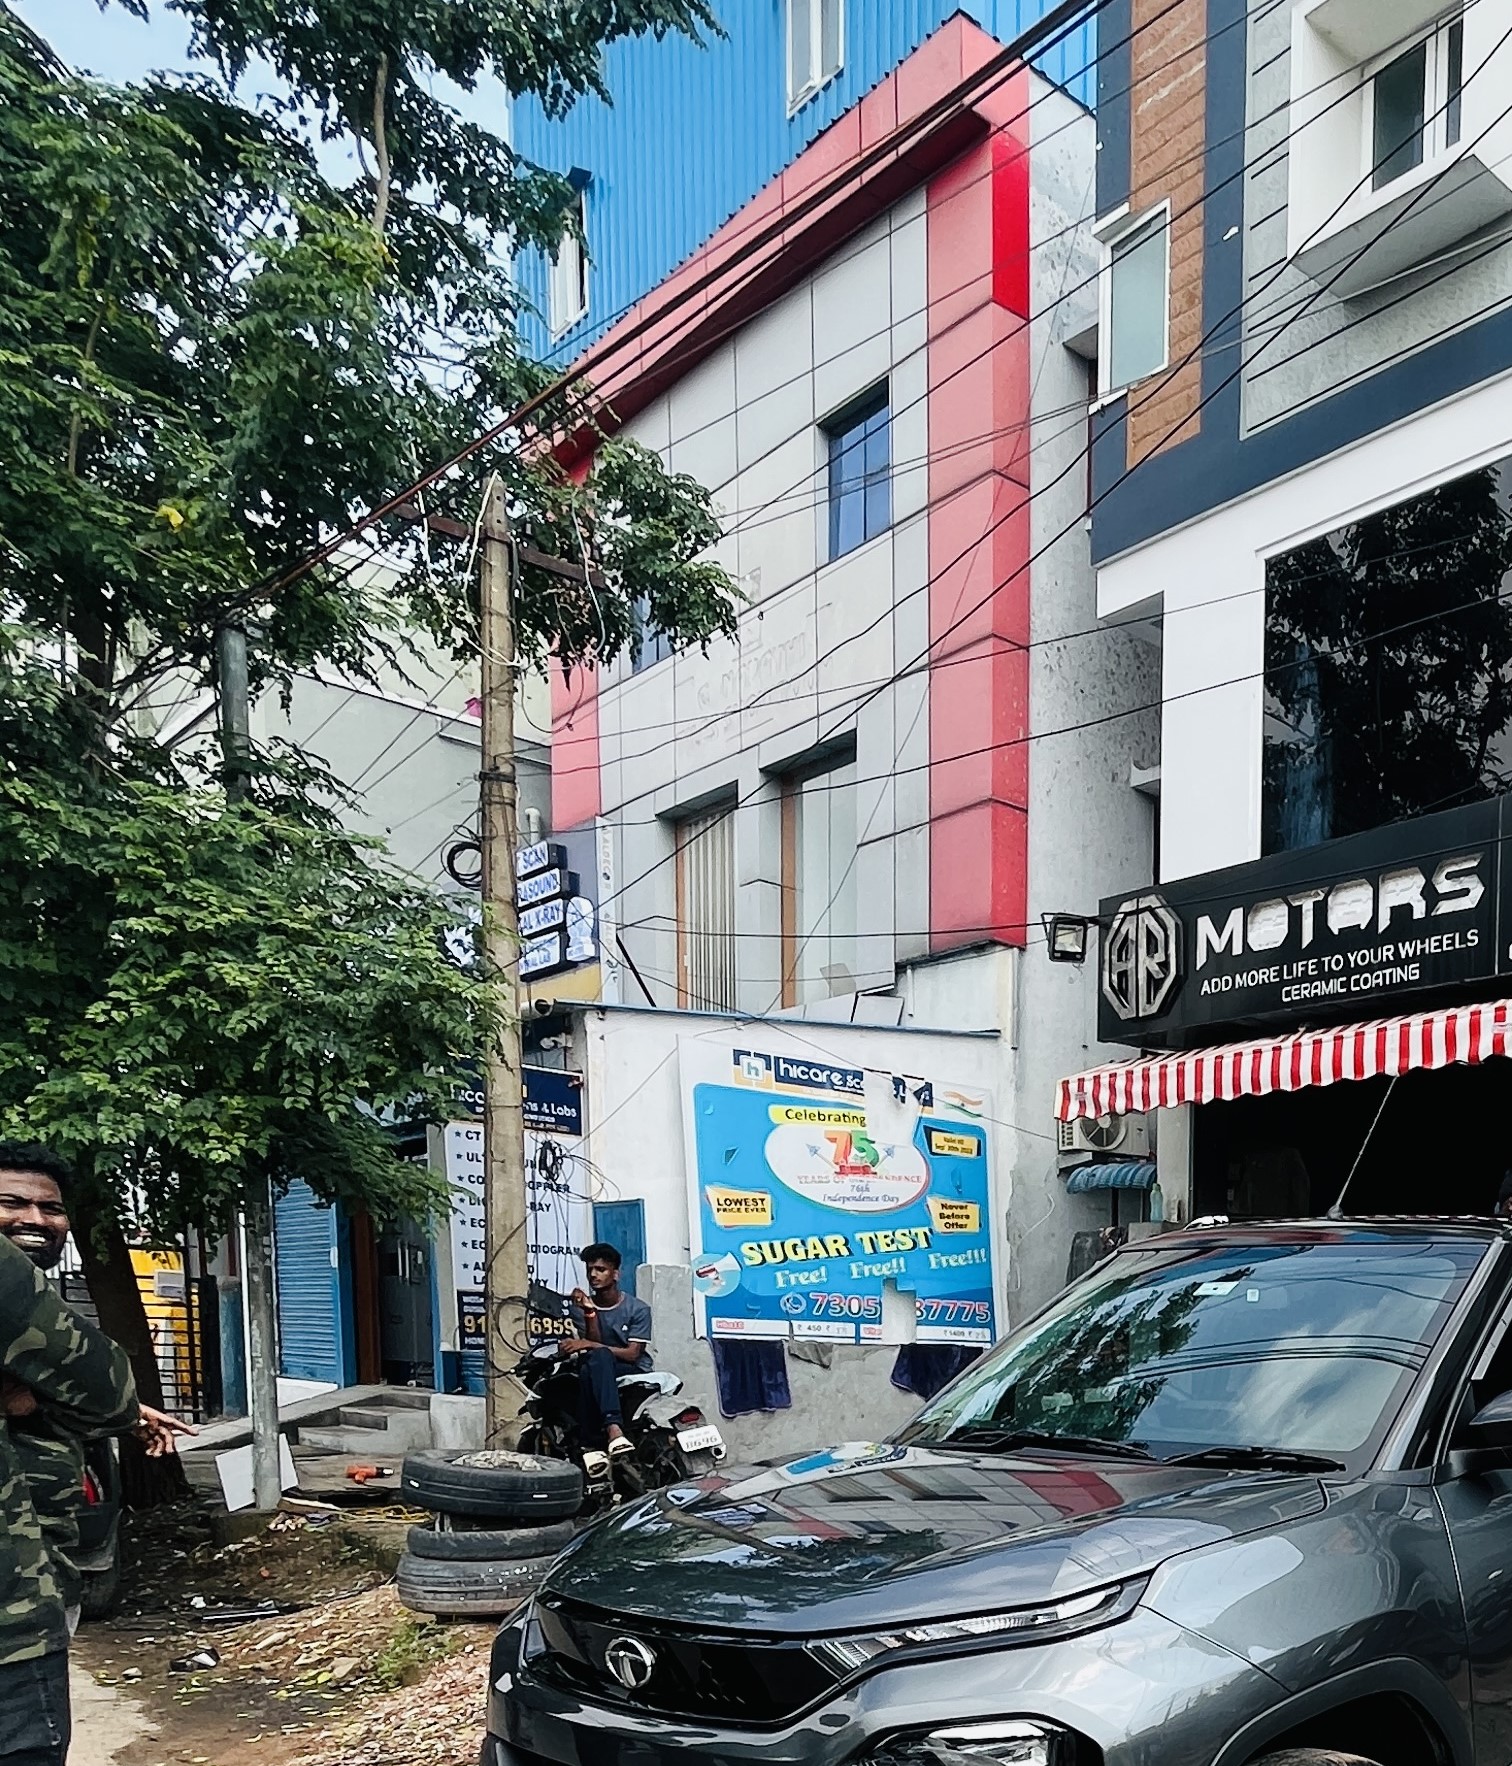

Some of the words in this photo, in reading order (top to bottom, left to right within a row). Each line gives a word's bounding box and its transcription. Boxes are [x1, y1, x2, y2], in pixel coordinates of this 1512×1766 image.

[1195, 851, 1486, 971] MOTORS
[1200, 972, 1233, 997] ADD
[1235, 965, 1280, 992] MORE
[1282, 955, 1319, 981] LIFE
[1320, 951, 1345, 974] TO
[1347, 942, 1395, 968] YOUR
[1398, 928, 1480, 959] WHEELS
[1281, 979, 1347, 1002] CERAMIC
[1349, 963, 1421, 991] COATING
[779, 1059, 844, 1086] hicare
[551, 1102, 578, 1118] Labs
[785, 1108, 867, 1127] Celebrating
[465, 1130, 482, 1141] CT
[716, 1197, 767, 1207] LOWEST
[740, 1234, 853, 1267] SUGAR
[855, 1226, 933, 1256] TEST
[775, 1265, 828, 1289] Free!
